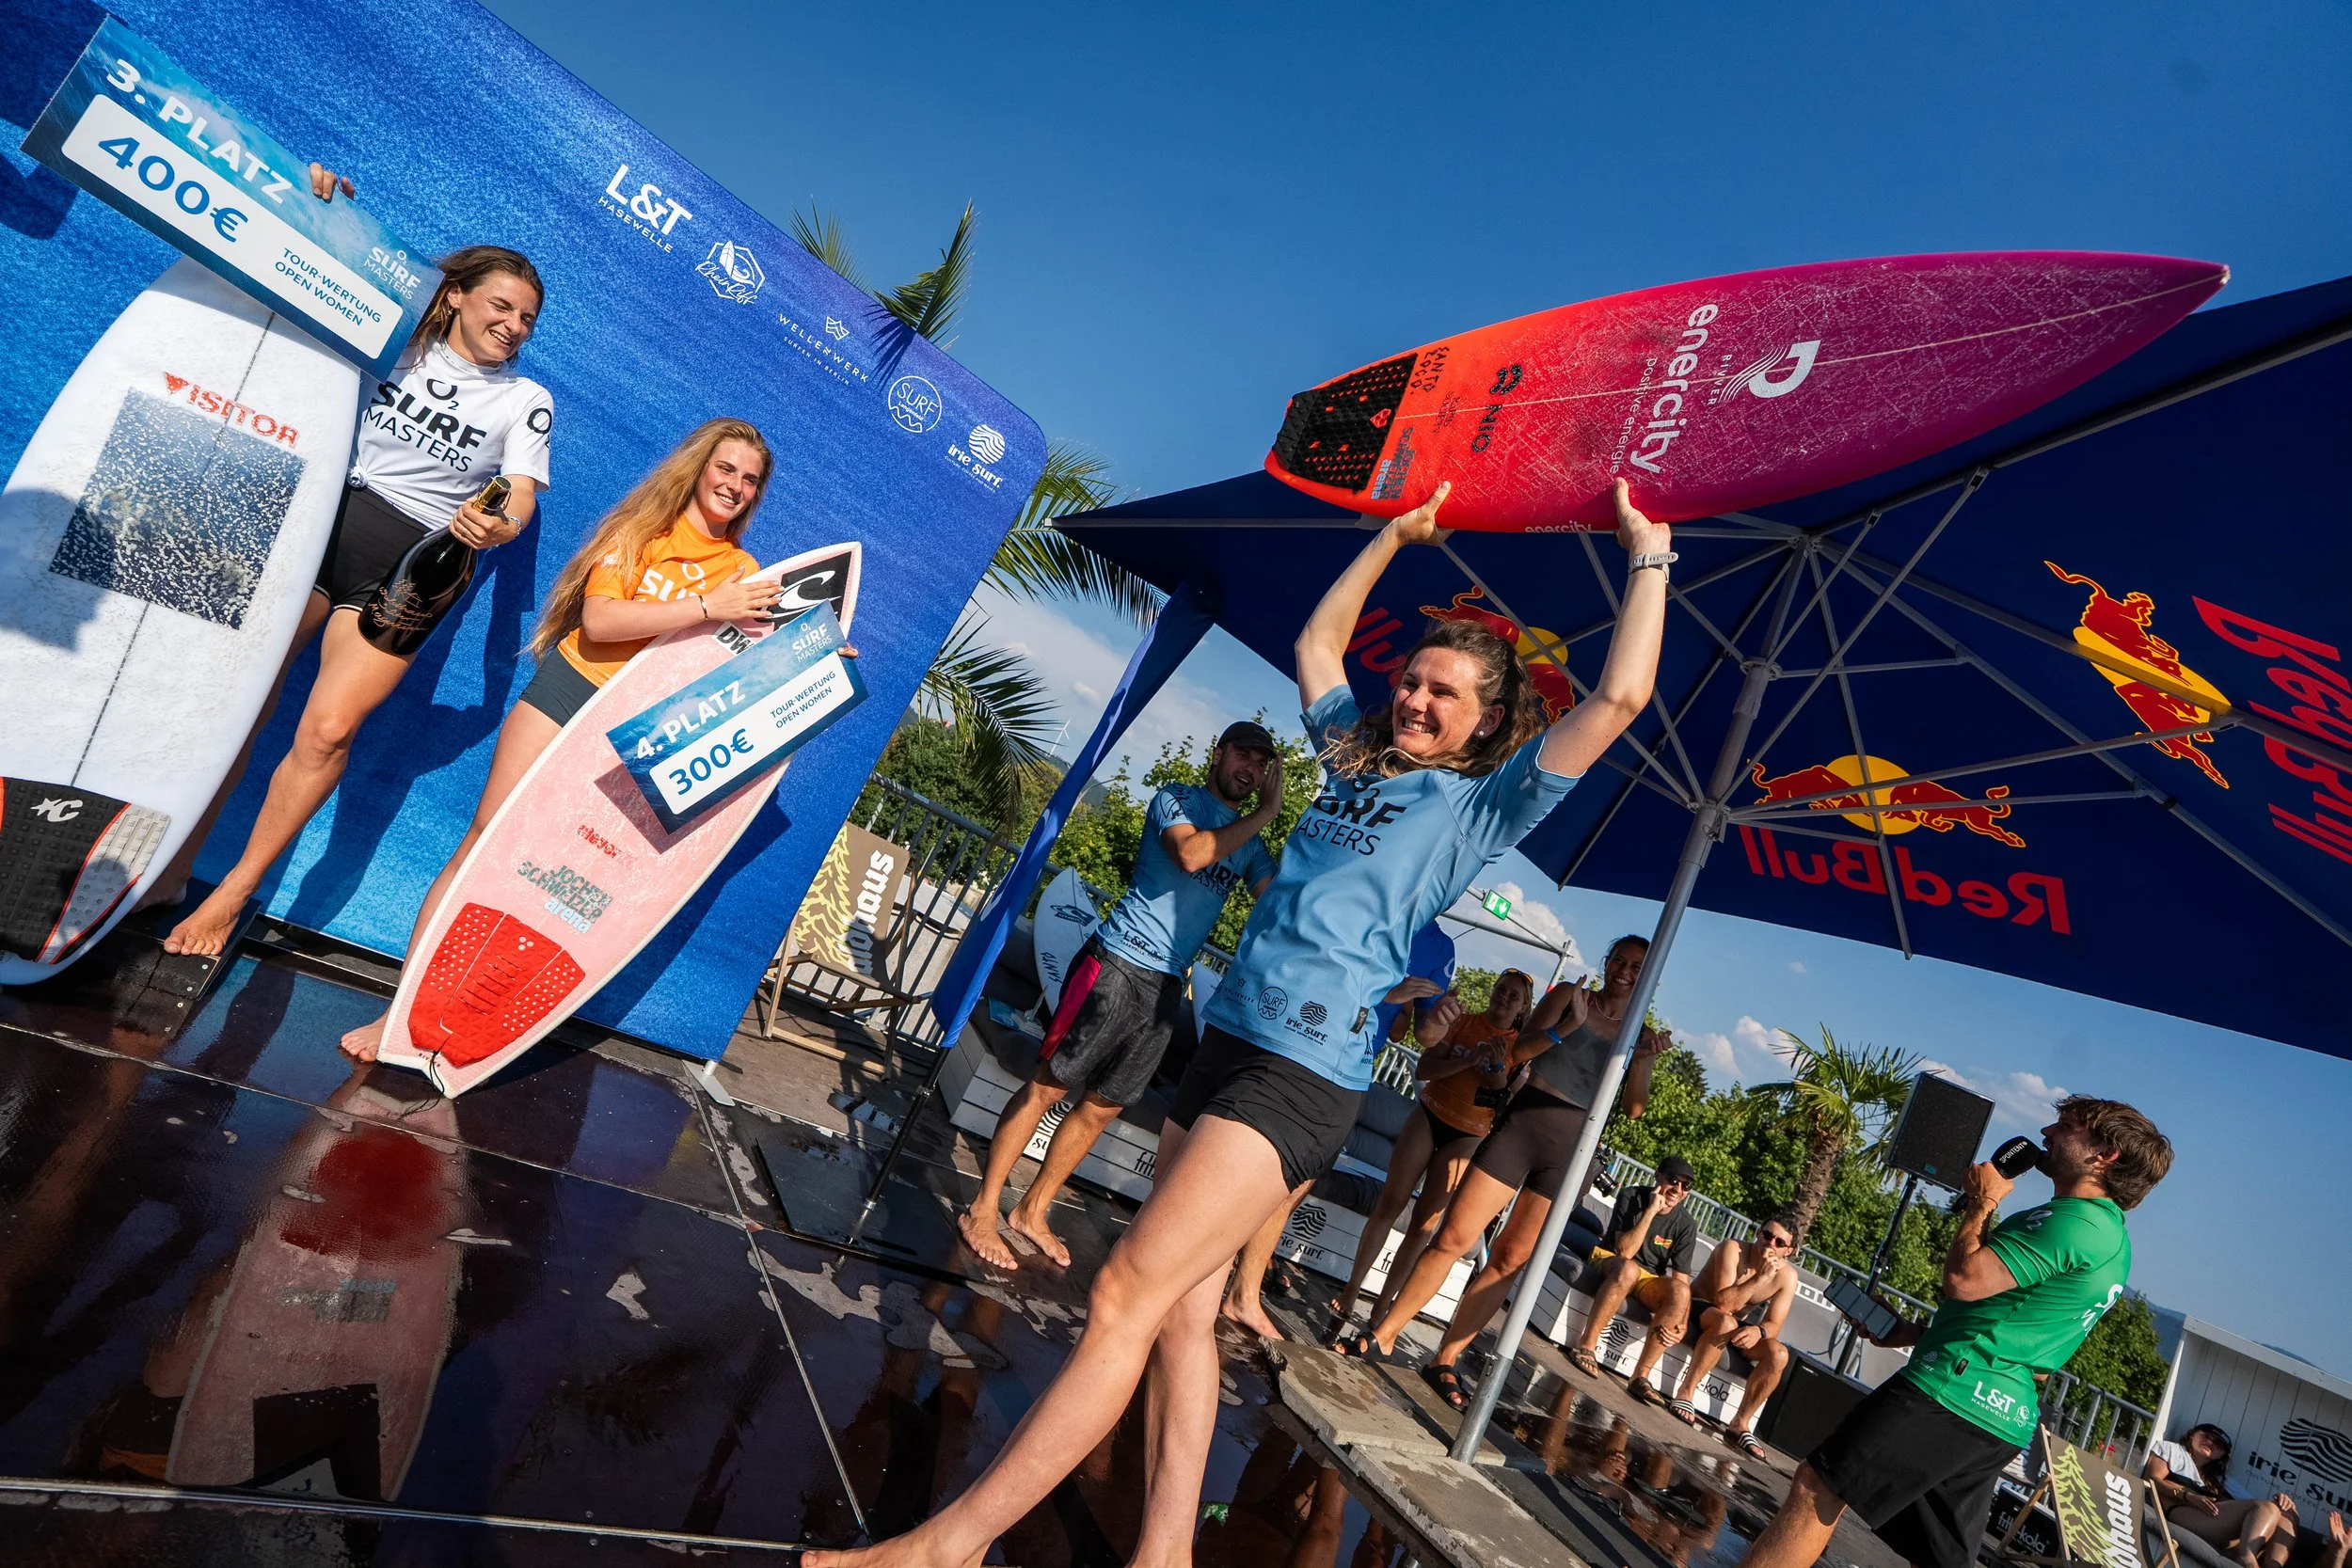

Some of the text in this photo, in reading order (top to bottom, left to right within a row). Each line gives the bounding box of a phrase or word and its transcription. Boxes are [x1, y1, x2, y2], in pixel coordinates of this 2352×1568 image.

[106, 58, 294, 204] 3. PLATZ
[97, 136, 248, 243] 400€
[605, 163, 693, 235] L&T
[597, 196, 674, 254] HASEWELLE
[283, 247, 382, 324] TOUR-WERTUNG
[363, 259, 415, 300] MASTERS
[368, 246, 421, 289] SURF
[275, 261, 363, 326] OPEN WOMEN
[778, 313, 869, 383] WELLENWERK
[783, 336, 811, 359] SURFEN
[824, 365, 850, 386] BERLIN
[897, 382, 939, 417] SURF
[1629, 304, 1719, 474] enercity
[371, 380, 487, 450] SURF
[1610, 356, 1658, 474] positive energie
[363, 406, 472, 472] MASTERS
[947, 444, 972, 467] irie
[1371, 459, 1391, 499] arena
[791, 623, 828, 656] SURF
[797, 635, 833, 663] MASTERS
[770, 670, 836, 719] TOUR-WERTUNG
[775, 686, 833, 729] OPEN WOMEN
[636, 680, 747, 760] 4. PLATZ
[669, 728, 755, 797] 300€
[1312, 795, 1407, 829] URF
[1295, 816, 1381, 856] ASTERS
[544, 896, 592, 934] arena
[1262, 992, 1286, 1006] SURF
[1285, 1017, 1303, 1031] irie
[1999, 1142, 2025, 1164] SPONTENT
[1279, 1235, 1294, 1249] rie
[1971, 1398, 2011, 1422] HASEWELLE
[1973, 1381, 2016, 1413] L&T
[2248, 1451, 2297, 1486] irie
